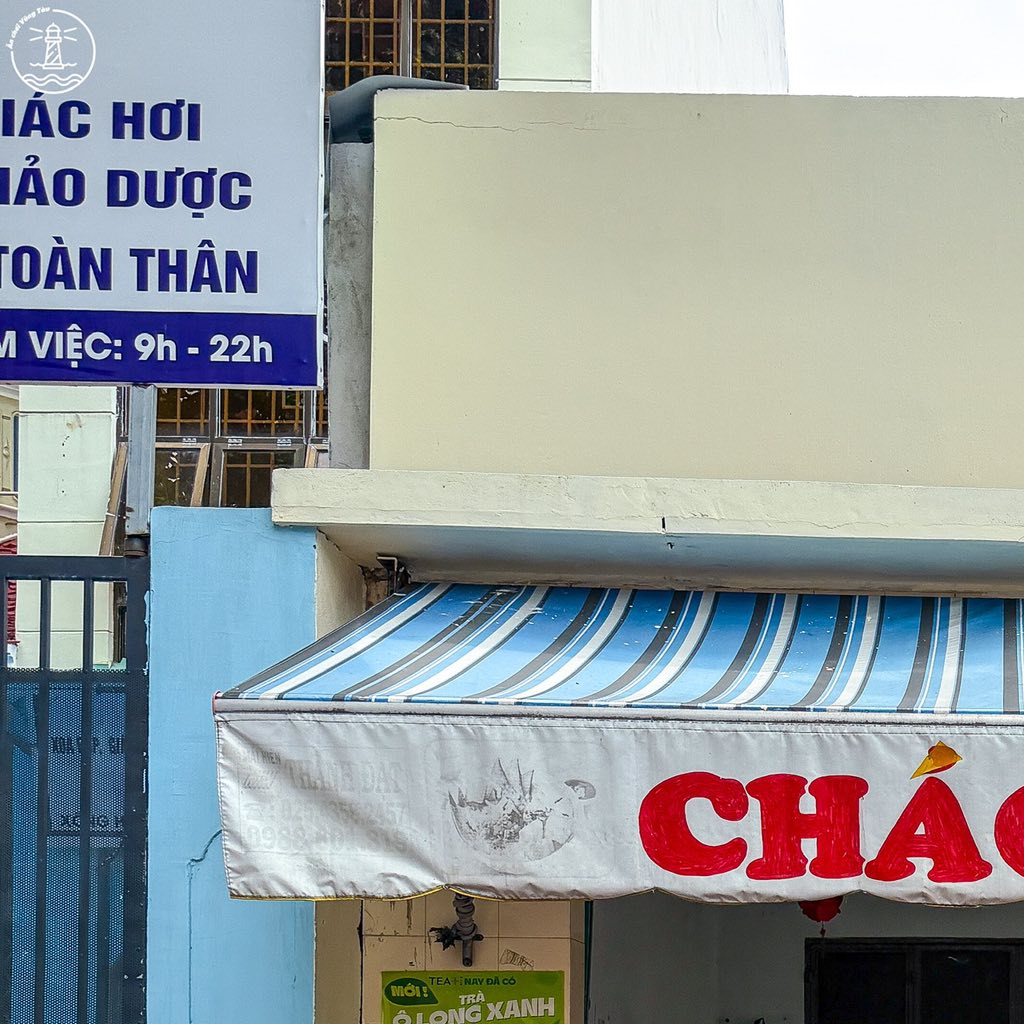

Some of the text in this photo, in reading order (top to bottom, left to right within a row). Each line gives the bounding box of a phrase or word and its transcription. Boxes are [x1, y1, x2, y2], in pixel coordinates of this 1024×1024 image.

[112, 99, 201, 141] HƠI
[107, 167, 252, 218] DƯỢC
[129, 239, 258, 293] THÂN
[29, 323, 122, 368] VIỆC:
[134, 333, 177, 361] 9h
[209, 334, 273, 363] 22h
[459, 990, 485, 1005] TRÀ
[464, 977, 484, 986] NAY
[502, 975, 516, 986] CÓ
[486, 997, 555, 1021] XANH
